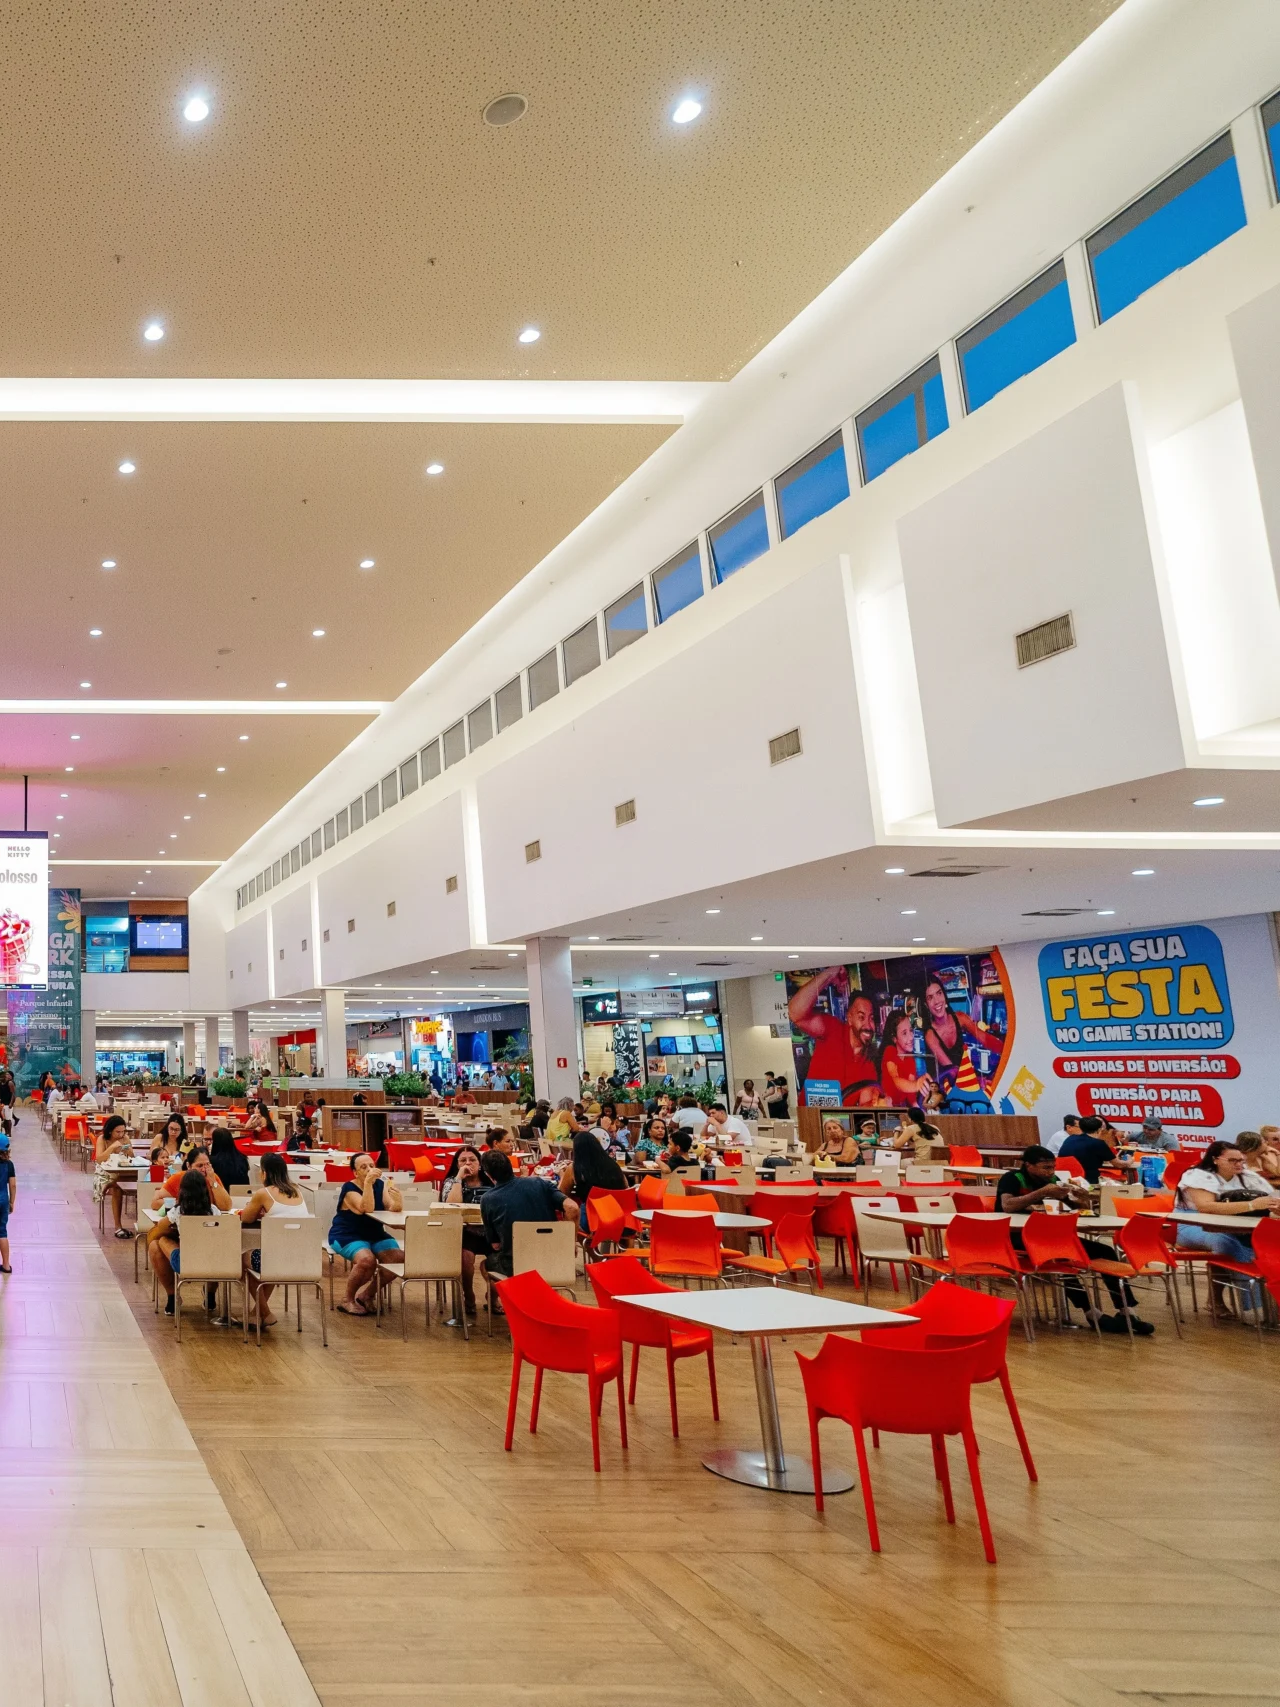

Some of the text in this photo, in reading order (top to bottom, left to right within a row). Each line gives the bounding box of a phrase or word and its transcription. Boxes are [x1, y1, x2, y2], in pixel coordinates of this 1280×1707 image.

[1062, 935, 1187, 972] FAÇA SUA
[1046, 964, 1224, 1022] FESTA
[20, 1000, 45, 1008] Parque
[39, 1022, 47, 1030] de
[48, 1022, 71, 1030] Festas
[474, 1012, 502, 1024] LONDON BUS
[1055, 1021, 1224, 1044] NO GAME STATION!
[1063, 1056, 1227, 1073] 03 HORAS DE DIVERSÃO!
[1090, 1084, 1202, 1103] DIVERSÃO PARA
[1092, 1103, 1204, 1120] TODA A FAMÍLIA
